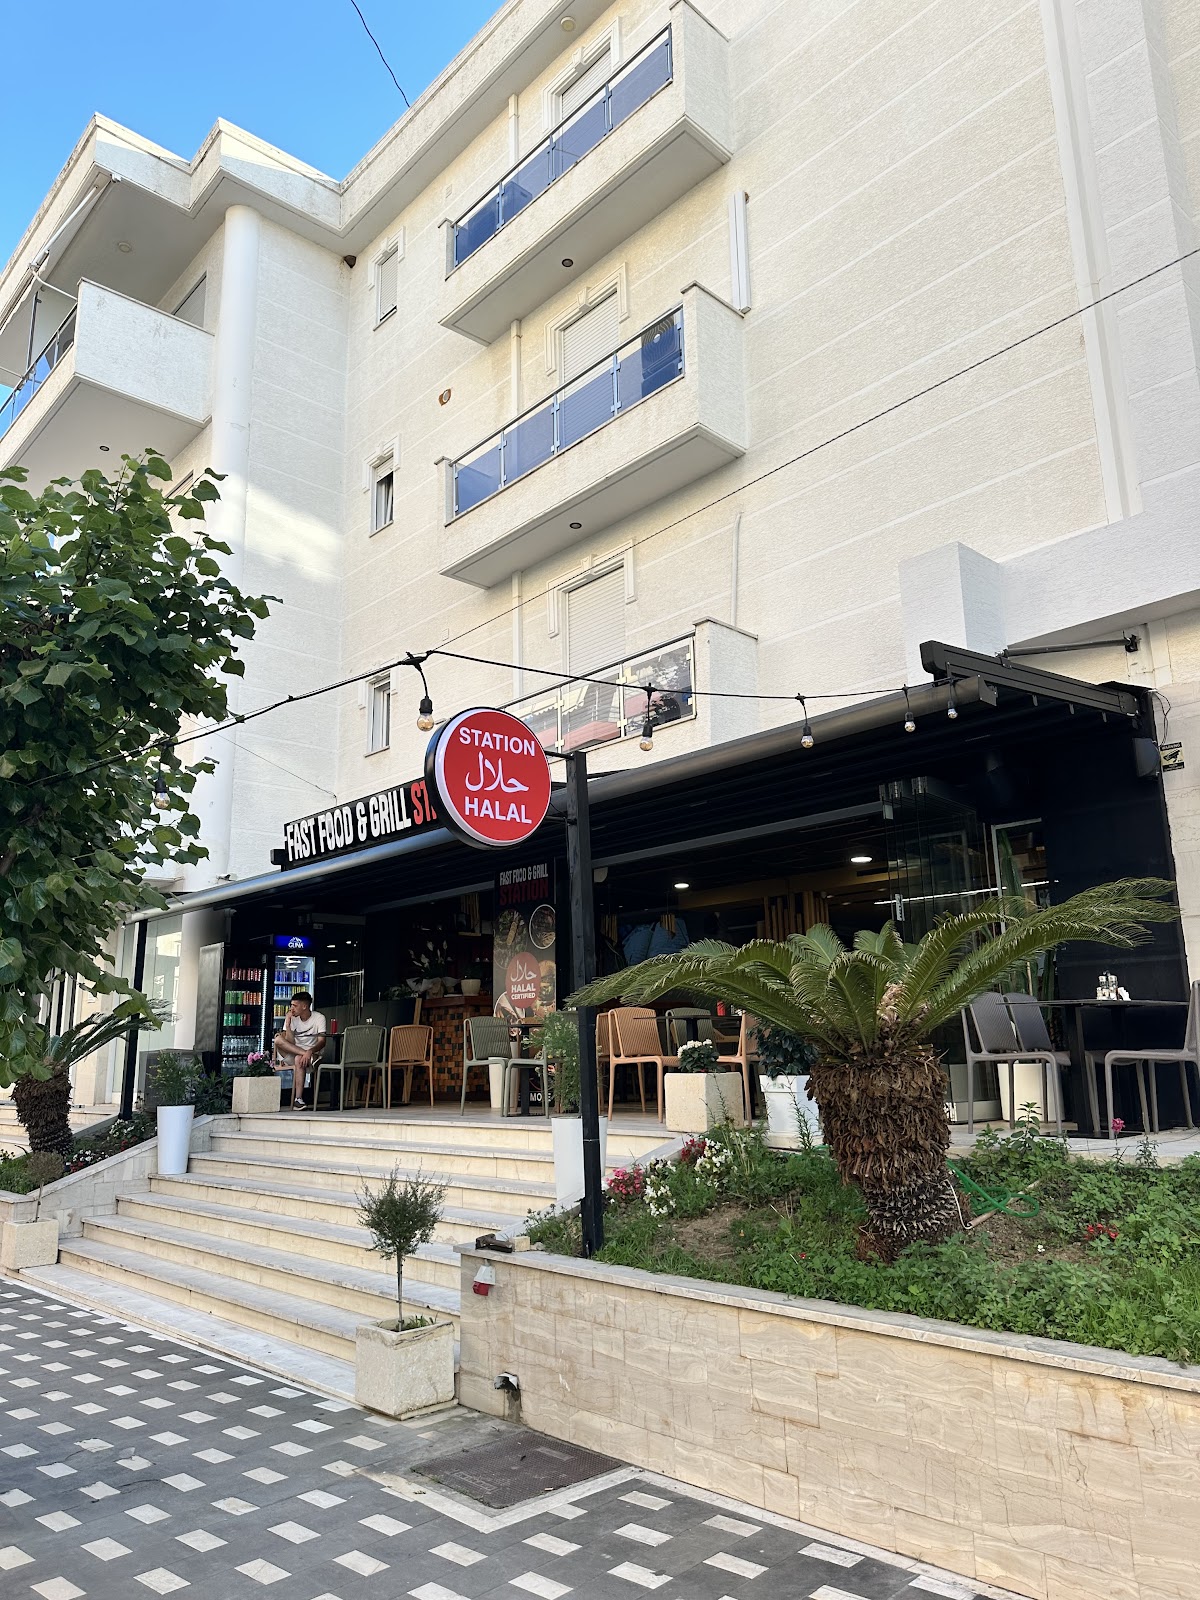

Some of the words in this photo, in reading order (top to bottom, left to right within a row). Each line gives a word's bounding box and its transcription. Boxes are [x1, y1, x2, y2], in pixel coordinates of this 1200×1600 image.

[459, 726, 536, 757] STATION
[464, 751, 530, 793] حلال
[286, 818, 317, 862] FAST
[317, 806, 354, 853] FOOD
[355, 801, 368, 842] &
[368, 787, 412, 838] GRILL
[410, 779, 437, 825] ST
[464, 796, 533, 824] HALAL
[499, 870, 512, 887] FAST
[512, 867, 527, 884] FOOD
[527, 866, 532, 881] &
[532, 862, 549, 880] GRILL
[499, 879, 549, 906] STATION
[510, 959, 537, 982] حلال
[510, 992, 536, 1000] CERTIFIED
[511, 983, 537, 993] HALAL
[529, 1092, 552, 1102] MOE
